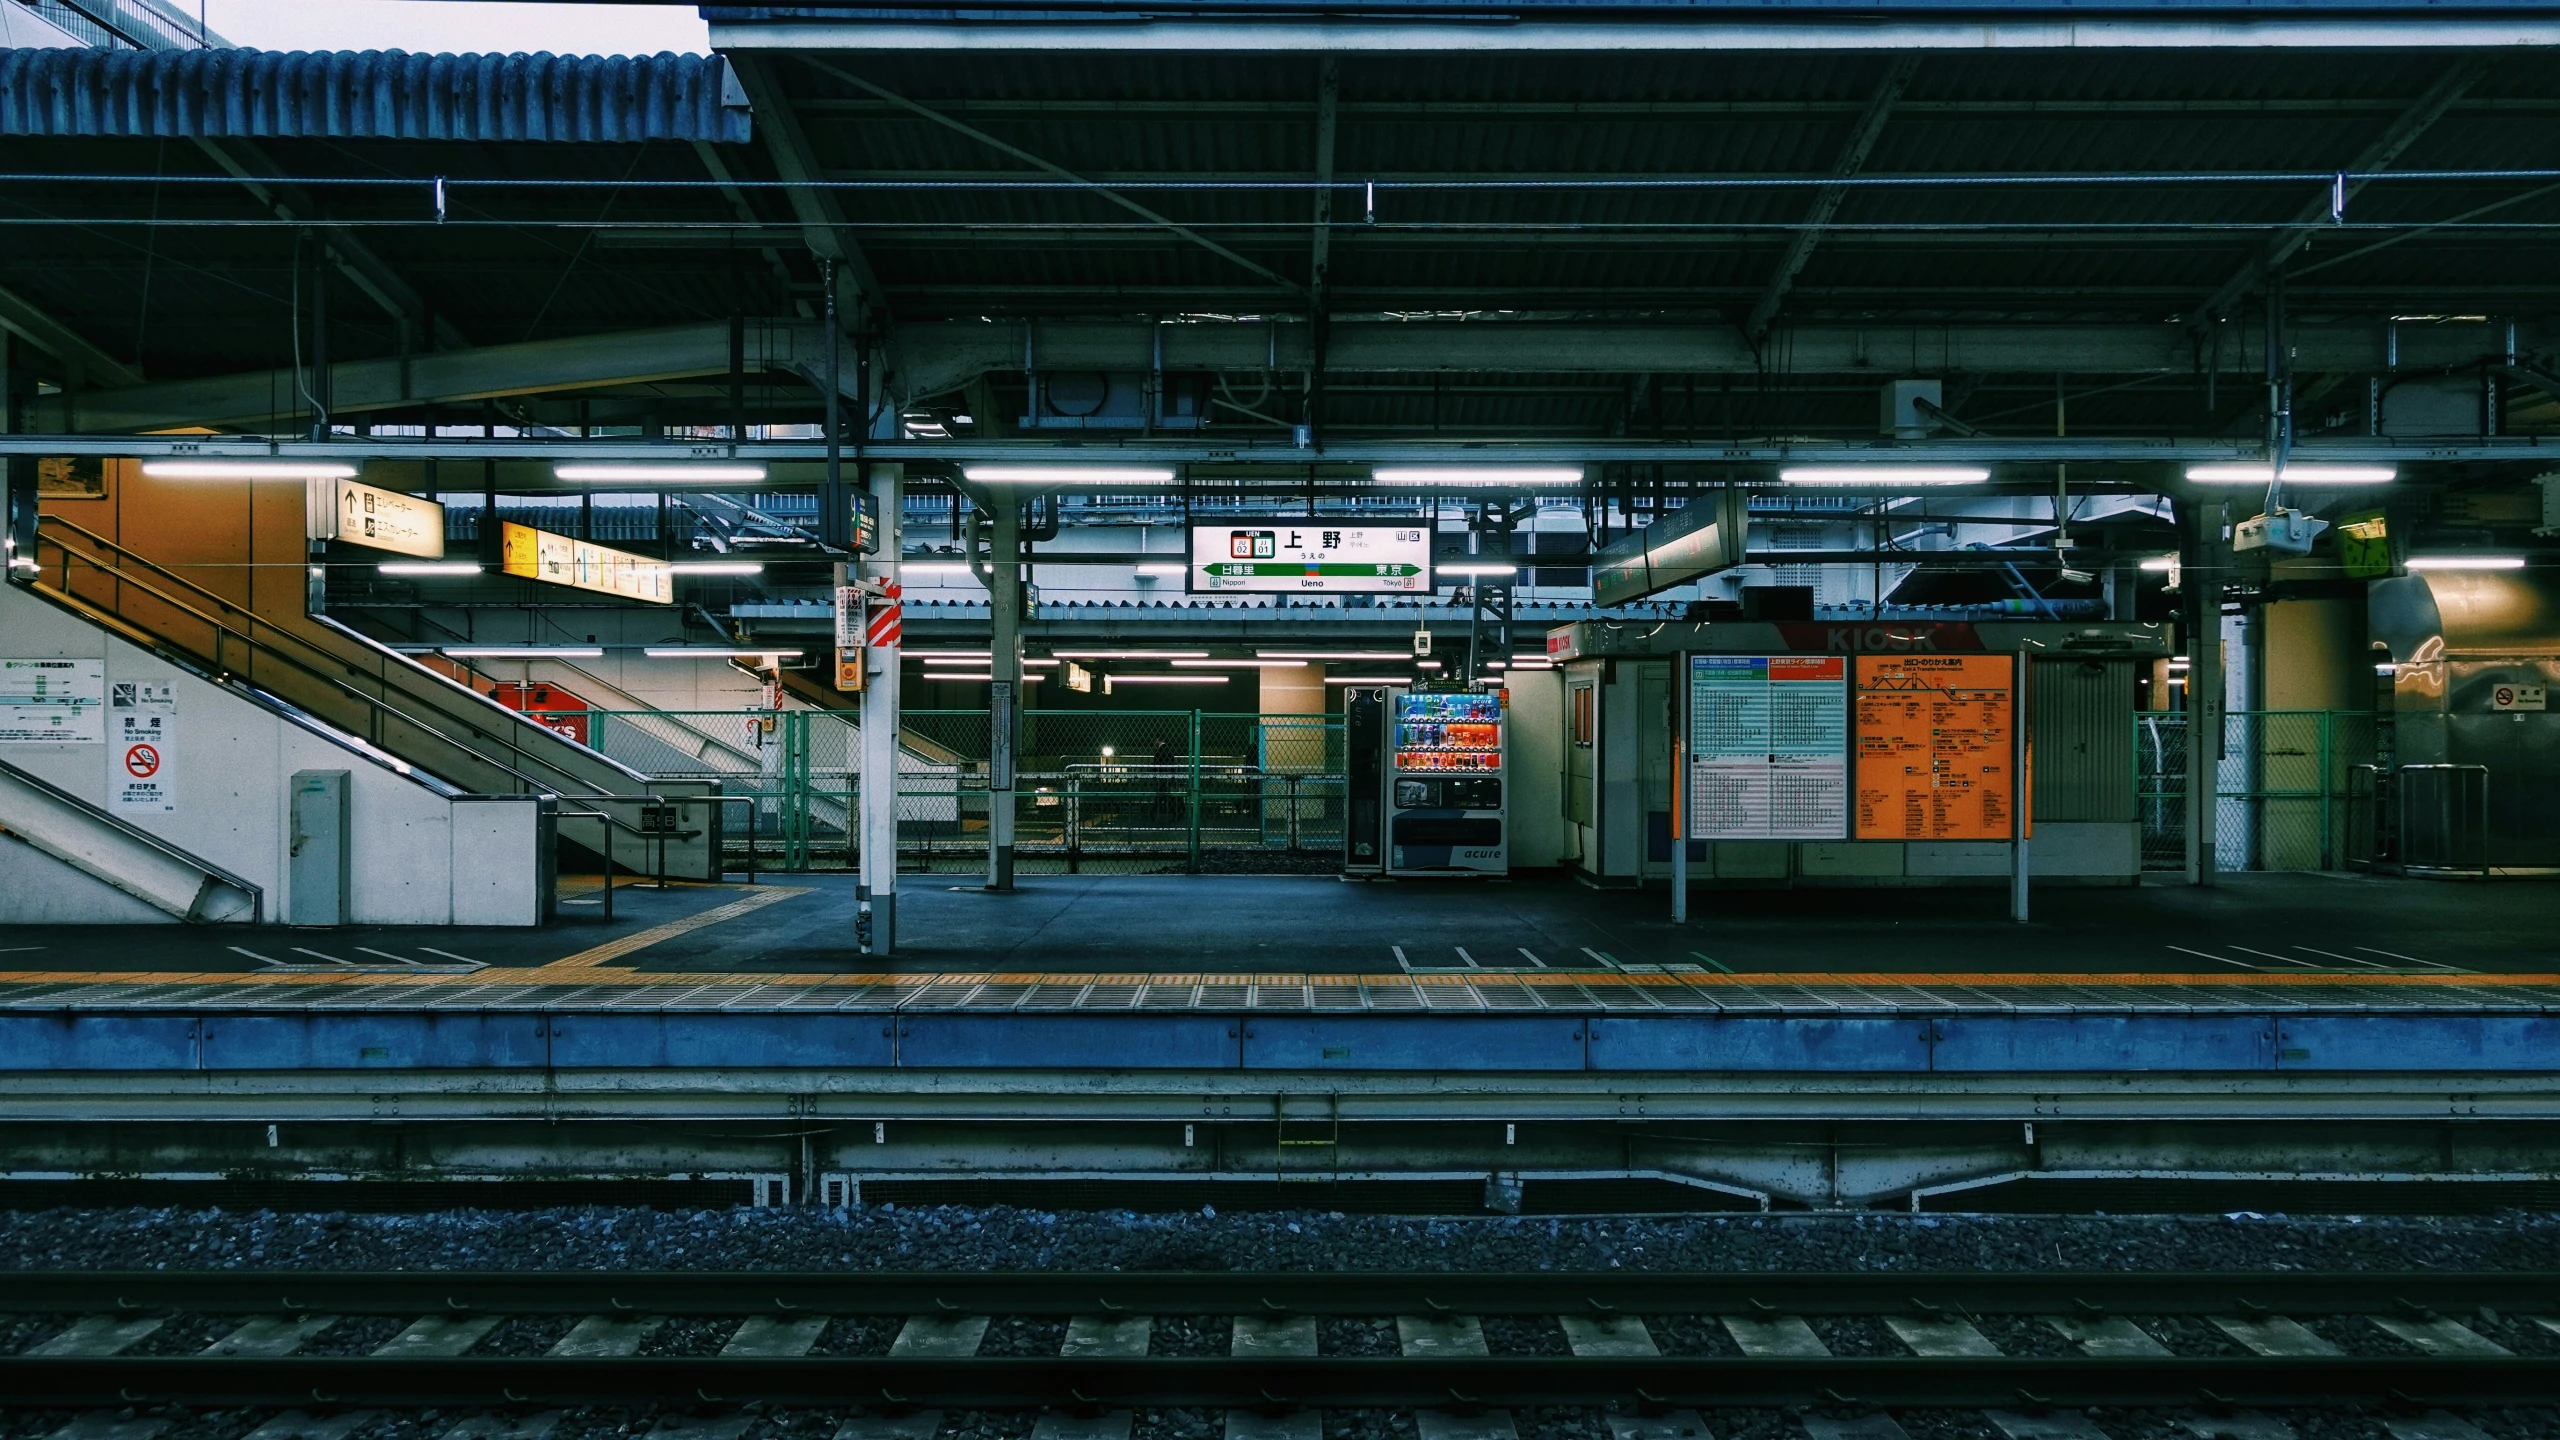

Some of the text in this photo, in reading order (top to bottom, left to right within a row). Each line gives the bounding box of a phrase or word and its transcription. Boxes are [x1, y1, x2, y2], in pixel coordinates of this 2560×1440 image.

[376, 496, 412, 512] エレベーター
[850, 493, 856, 522] 9
[377, 520, 419, 537] エスカレーター
[1284, 530, 1341, 549] 上野
[1236, 545, 1247, 554] 02
[1258, 545, 1268, 554] 01
[1300, 552, 1326, 560] うえの
[1222, 564, 1255, 576] 日暮里
[1376, 564, 1402, 575] 東京
[1222, 579, 1246, 587] Nippori
[1301, 579, 1324, 588] Ueno
[1827, 628, 1938, 650] KIOSK
[125, 717, 161, 728] 禁煙
[1464, 850, 1501, 858] acure
